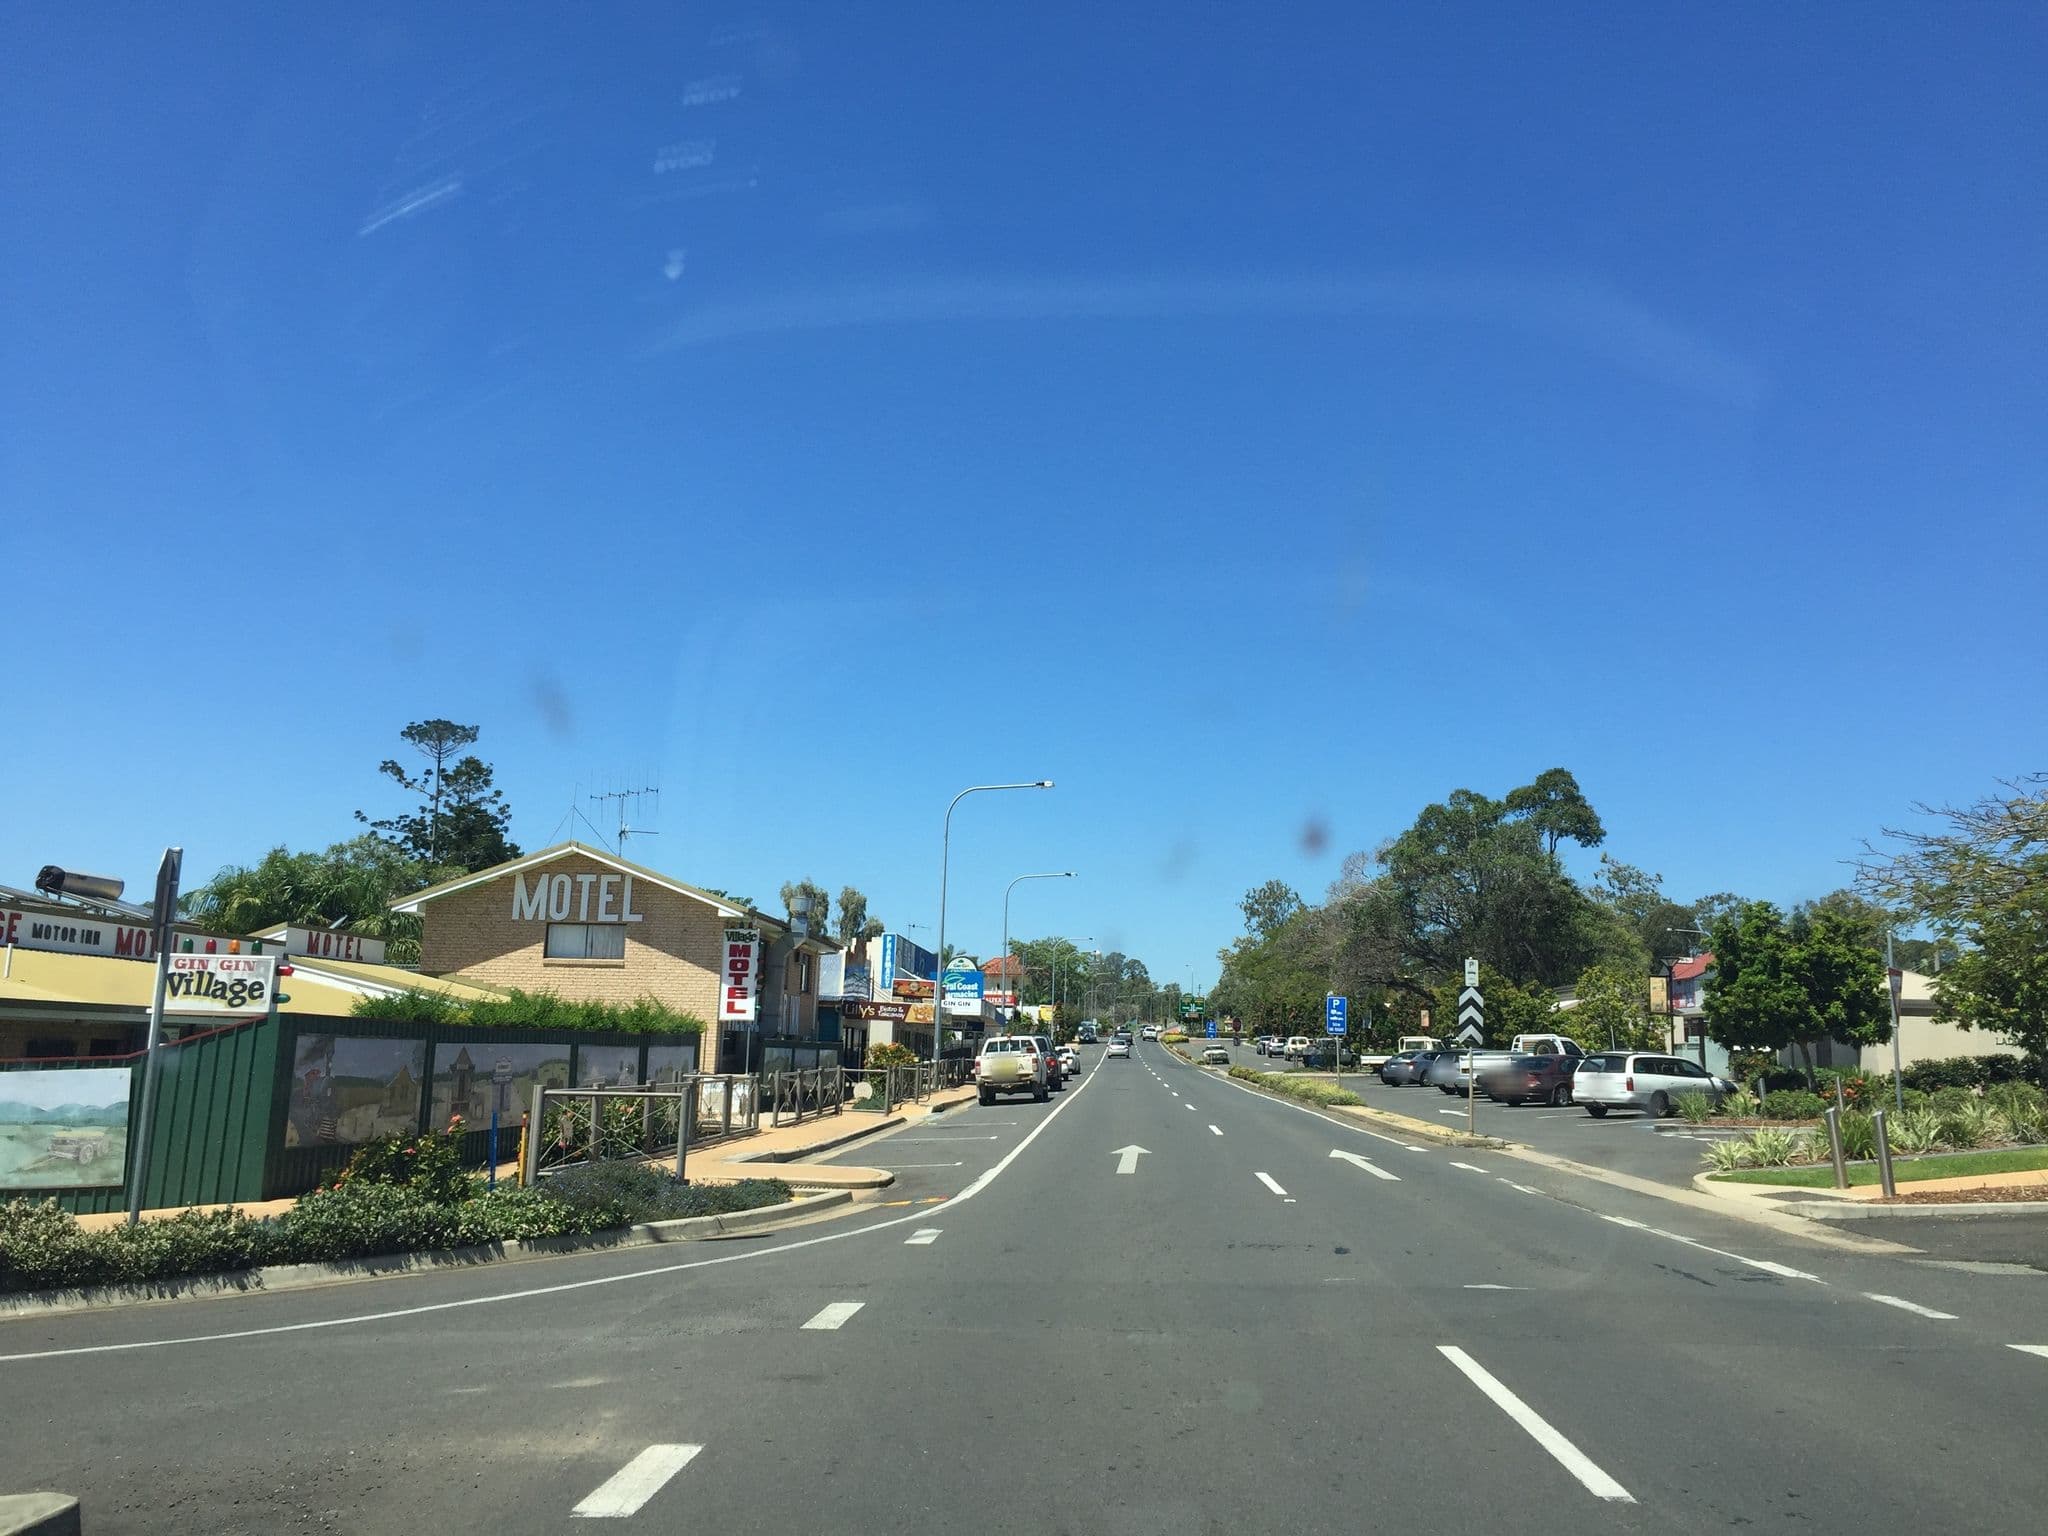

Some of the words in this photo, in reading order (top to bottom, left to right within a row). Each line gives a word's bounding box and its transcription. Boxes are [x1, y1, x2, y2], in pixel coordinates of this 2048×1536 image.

[511, 872, 644, 922] MOTEL
[32, 922, 76, 943] MOTOR
[80, 929, 101, 946] INN
[307, 931, 363, 961] MOTEL
[725, 931, 758, 943] Village
[174, 958, 210, 970] GIN
[219, 959, 257, 972] GIN
[167, 970, 265, 1008] Village
[726, 944, 751, 1014] MOTEL
[957, 982, 978, 990] Coast
[1332, 999, 1340, 1009] P
